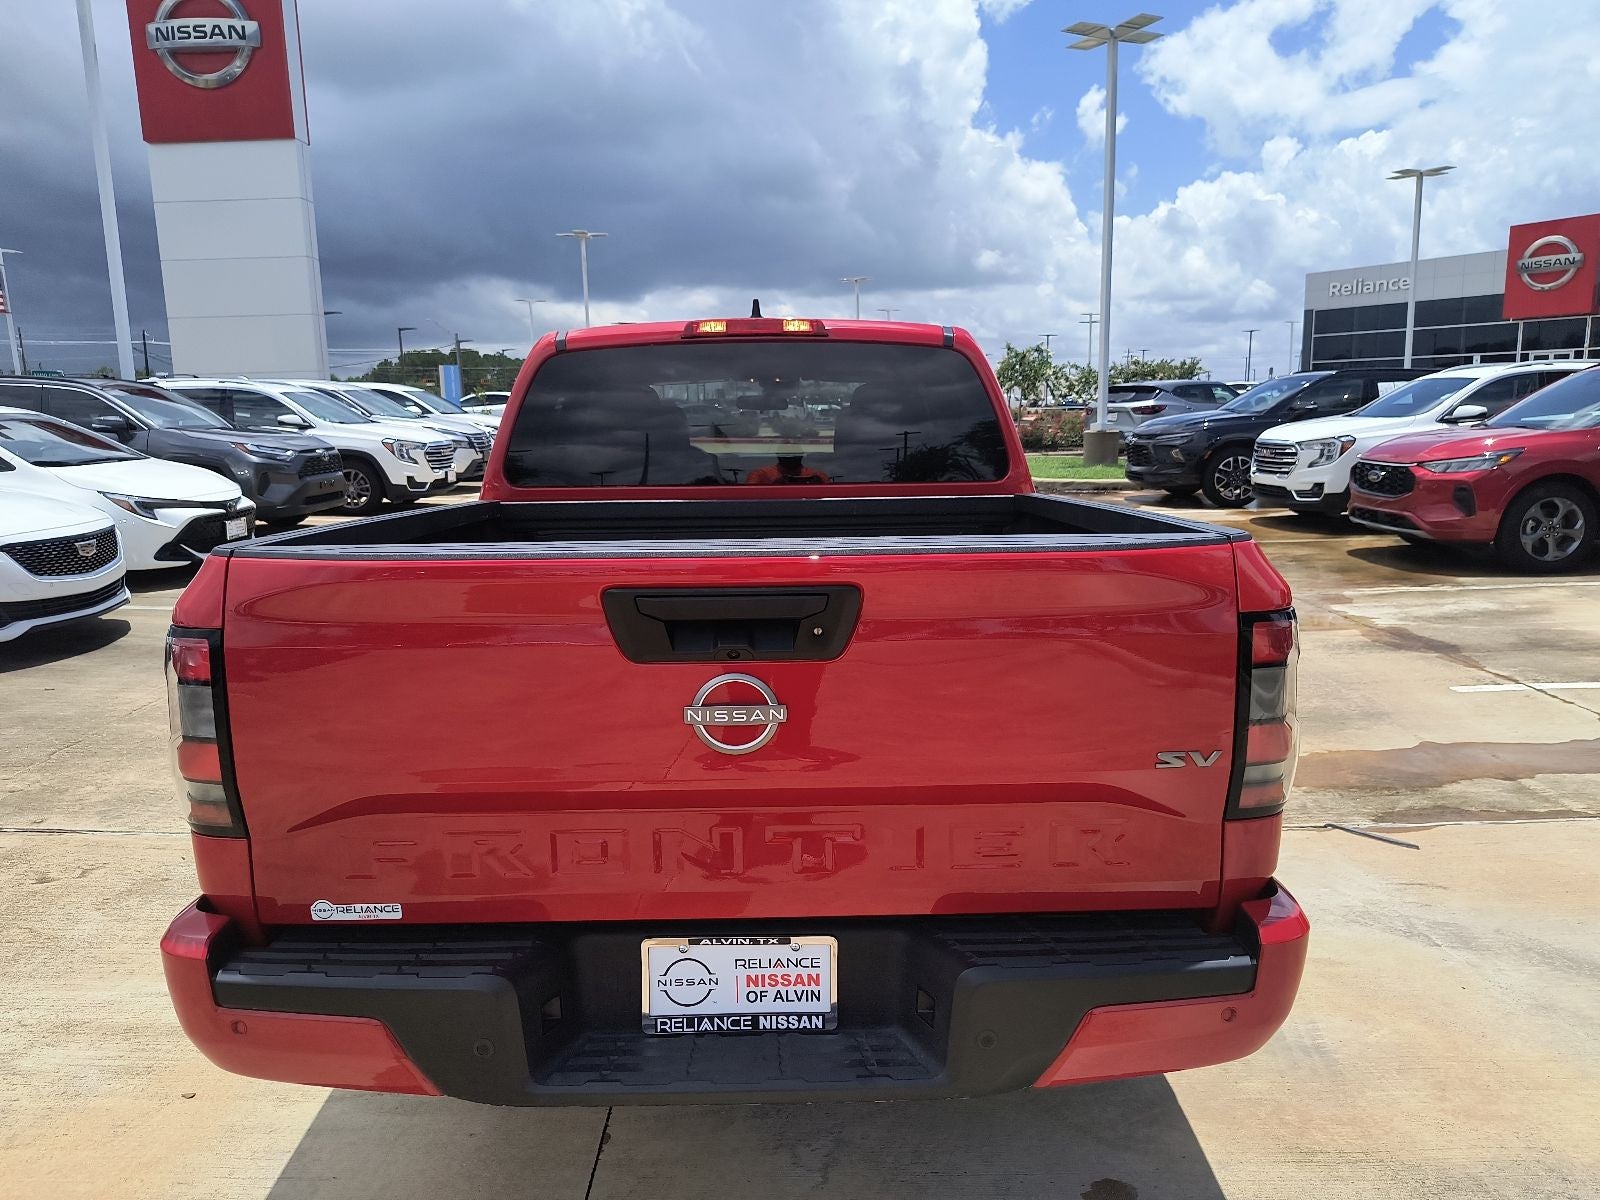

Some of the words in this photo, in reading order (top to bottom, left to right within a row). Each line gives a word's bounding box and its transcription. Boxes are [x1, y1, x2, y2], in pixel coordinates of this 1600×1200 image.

[154, 24, 247, 43] NISSAN
[1520, 256, 1577, 271] NISSAN
[1328, 276, 1411, 297] Reliance
[687, 708, 785, 722] NISSAN
[1155, 749, 1224, 770] SV
[345, 818, 1131, 880] FRONTIER
[335, 904, 400, 915] RELIANCE
[734, 957, 821, 970] RELIANCE
[657, 977, 719, 988] NISSAN
[745, 973, 821, 988] NISSAN
[745, 990, 769, 1003] OF
[772, 989, 821, 1003] ALVIN
[657, 1016, 752, 1033] RELIANCE
[758, 1015, 823, 1030] NISSAN
